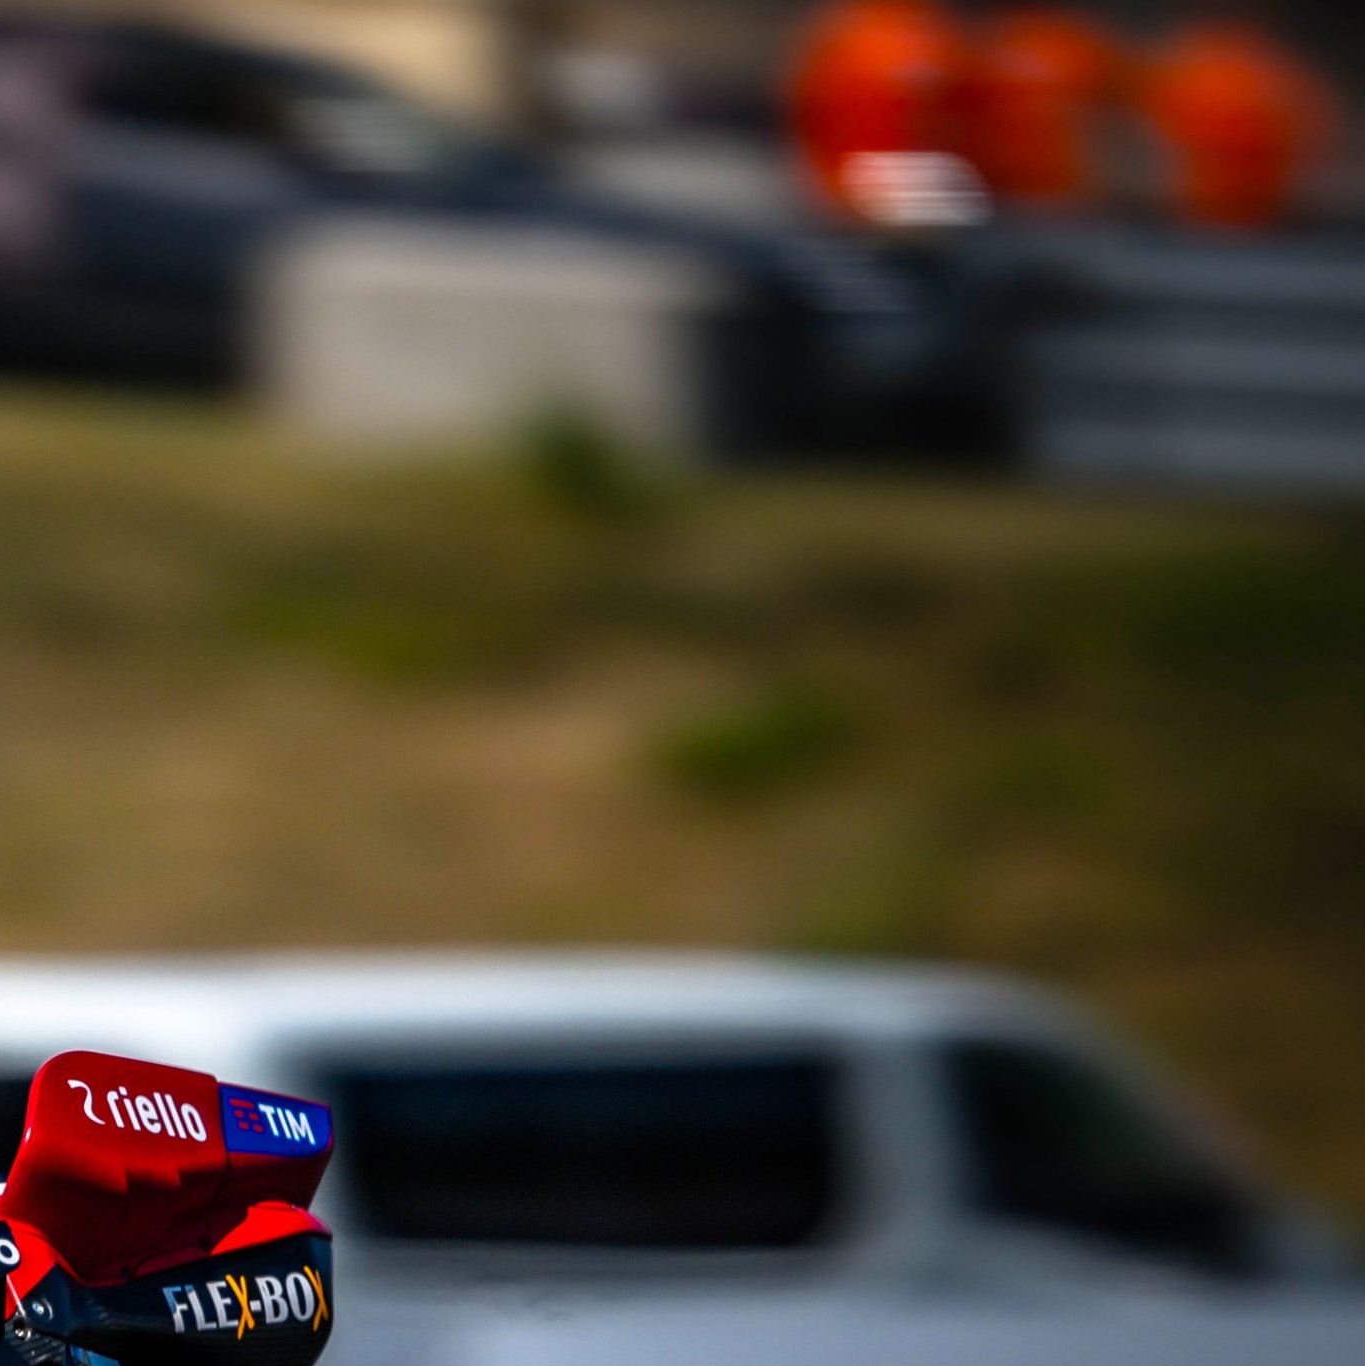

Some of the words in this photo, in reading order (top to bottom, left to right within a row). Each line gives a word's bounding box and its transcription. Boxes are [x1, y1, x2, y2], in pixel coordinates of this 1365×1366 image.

[107, 1086, 207, 1142] riello
[258, 1103, 316, 1145] TIM
[162, 1265, 329, 1340] FLEX-BOX
